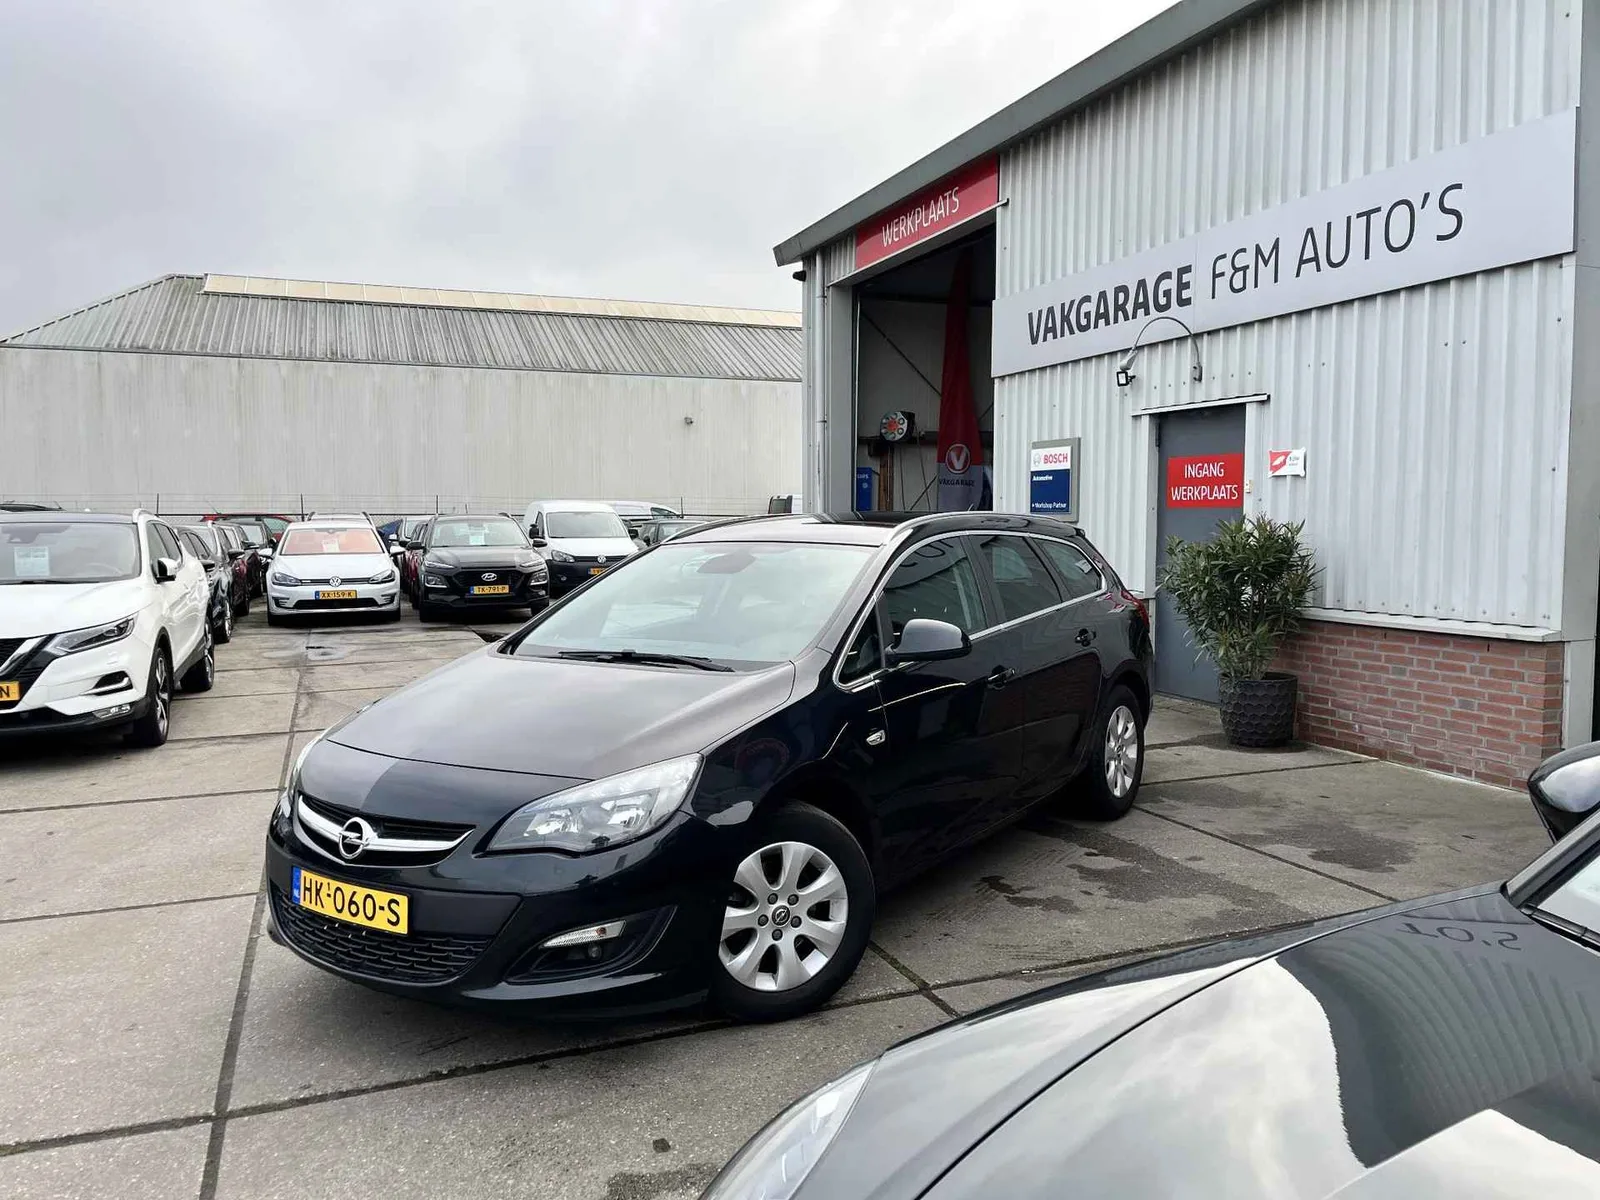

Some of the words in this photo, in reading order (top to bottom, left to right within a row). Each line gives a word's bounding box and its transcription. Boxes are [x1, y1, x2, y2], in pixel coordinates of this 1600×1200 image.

[881, 186, 960, 248] WERKPLAATS
[1027, 263, 1193, 346] VAKGARAGE
[1210, 236, 1281, 300] F&M
[1295, 182, 1464, 278] AUTO'S
[1043, 453, 1069, 464] BOSCH
[1184, 462, 1225, 478] INGANG
[1171, 484, 1239, 501] WERKPLAATS
[302, 875, 401, 927] HK-060-S
